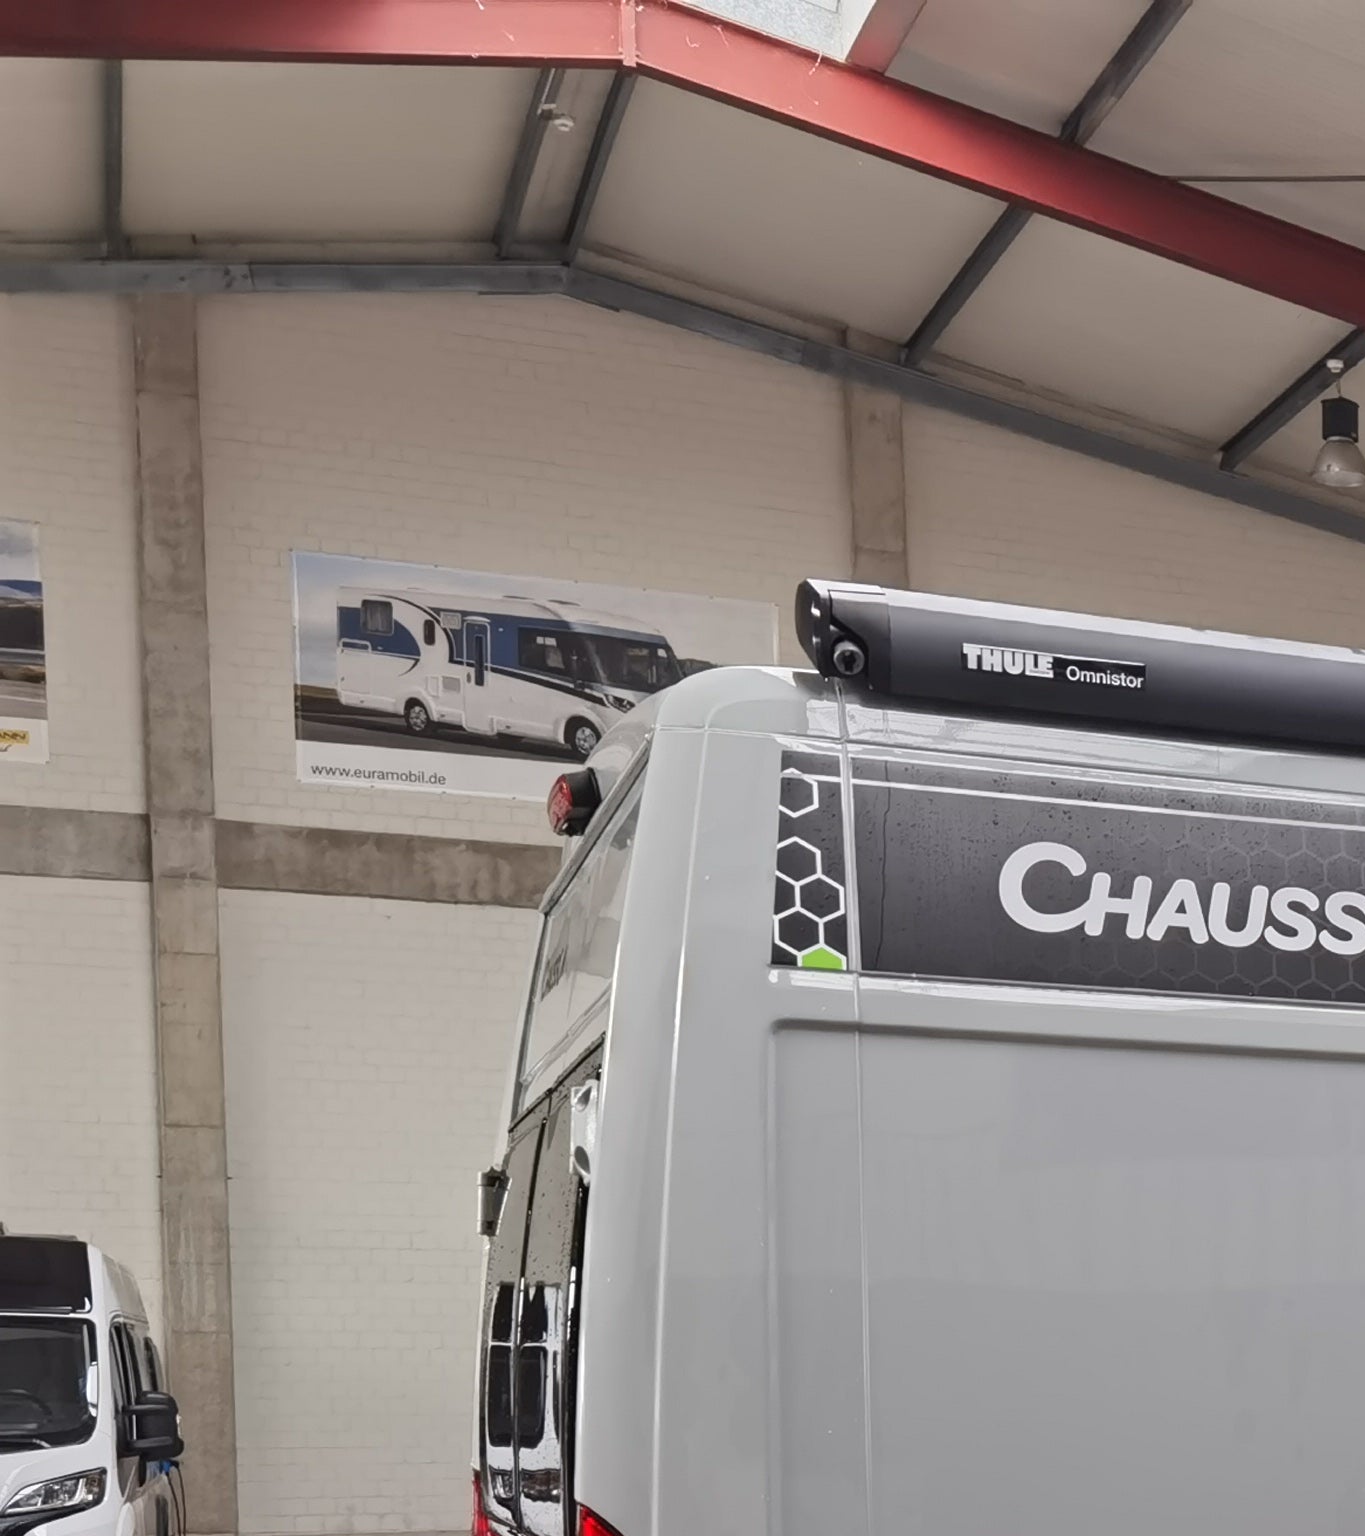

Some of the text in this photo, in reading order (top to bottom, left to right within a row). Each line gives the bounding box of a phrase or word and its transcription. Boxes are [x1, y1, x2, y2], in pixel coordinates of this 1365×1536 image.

[962, 643, 1144, 688] THULE Omnistor
[311, 765, 447, 785] www.euramobil.de
